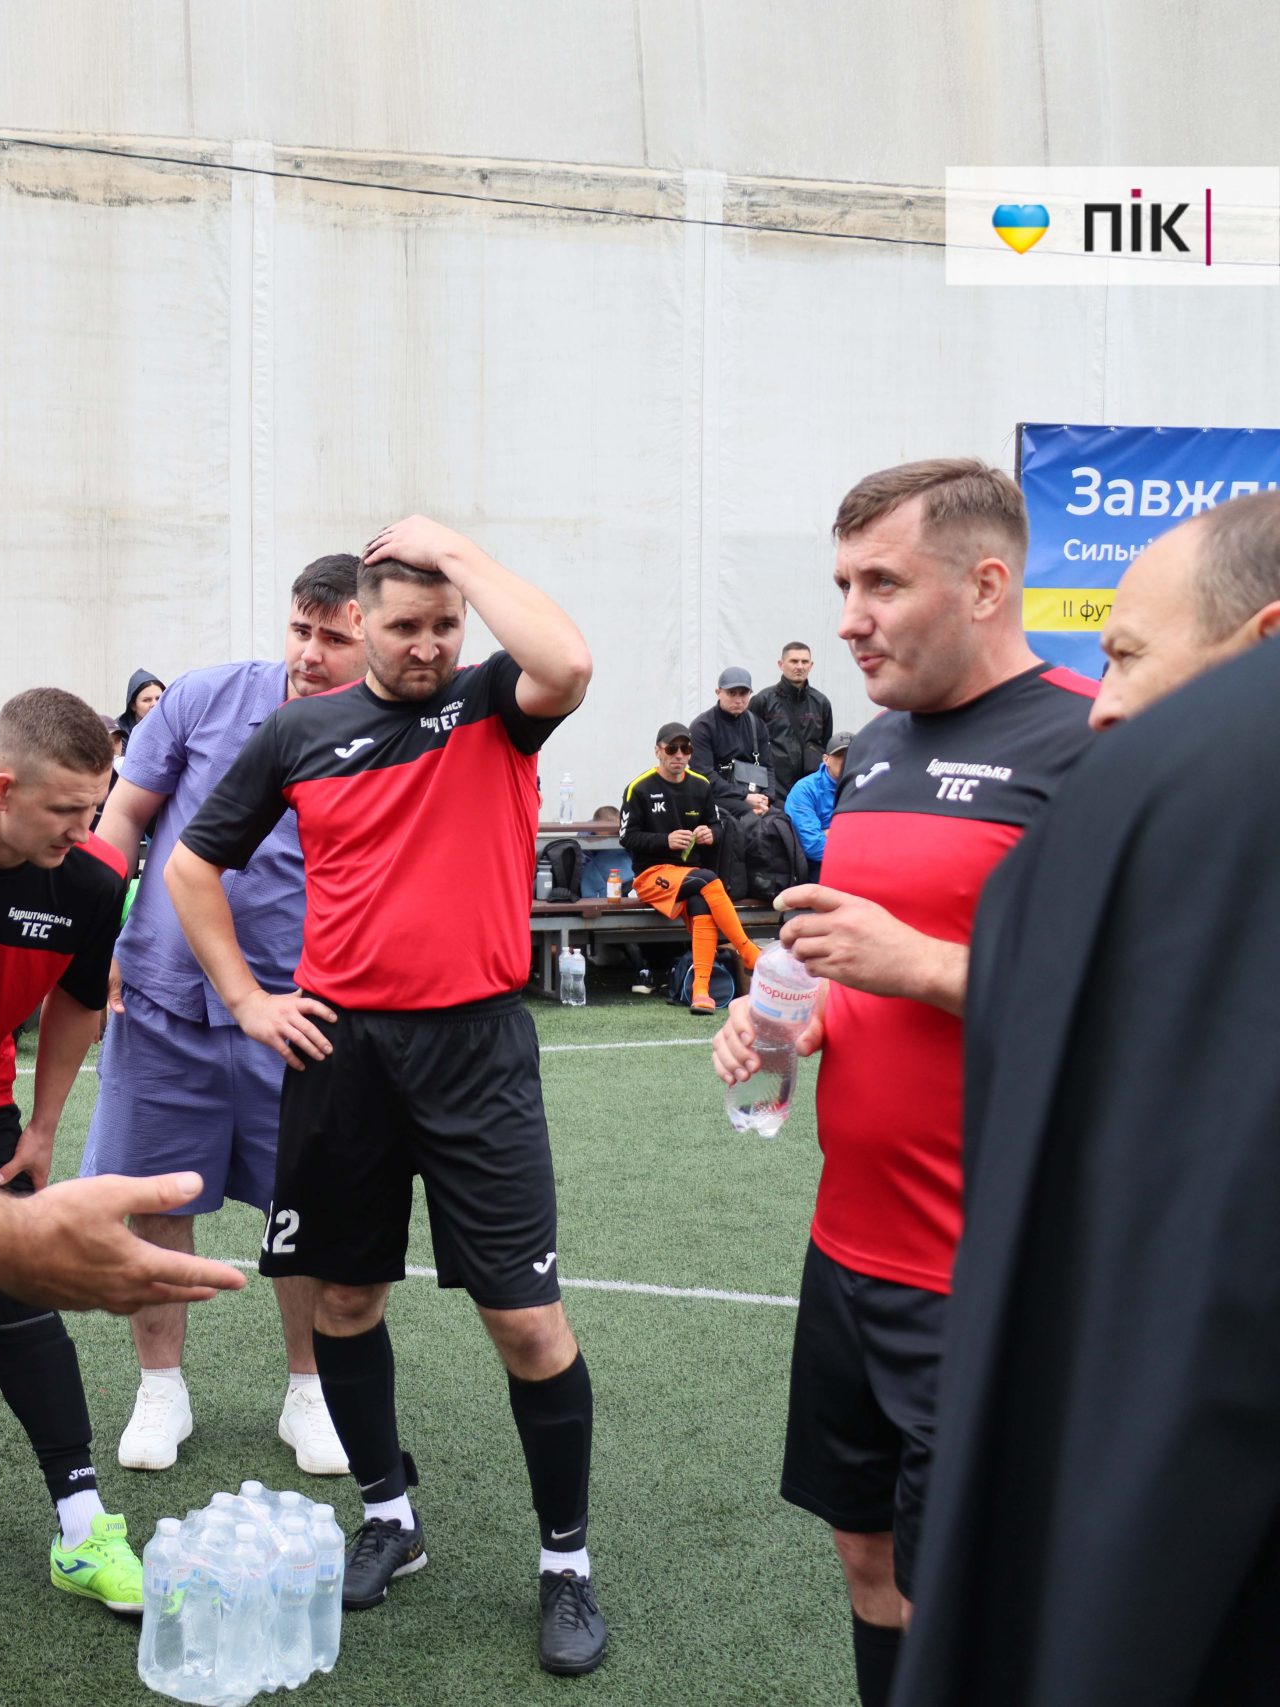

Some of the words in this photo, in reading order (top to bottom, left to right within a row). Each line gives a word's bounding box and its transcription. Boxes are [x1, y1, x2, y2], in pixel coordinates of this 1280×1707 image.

[1066, 466, 1277, 517] Завж
[1063, 537, 1153, 561] Сильн
[926, 758, 1012, 781] Бурштинська
[936, 777, 980, 802] ТЕС
[651, 801, 666, 813] JK
[8, 906, 73, 928] Бурштинська
[21, 921, 52, 939] ТЕС
